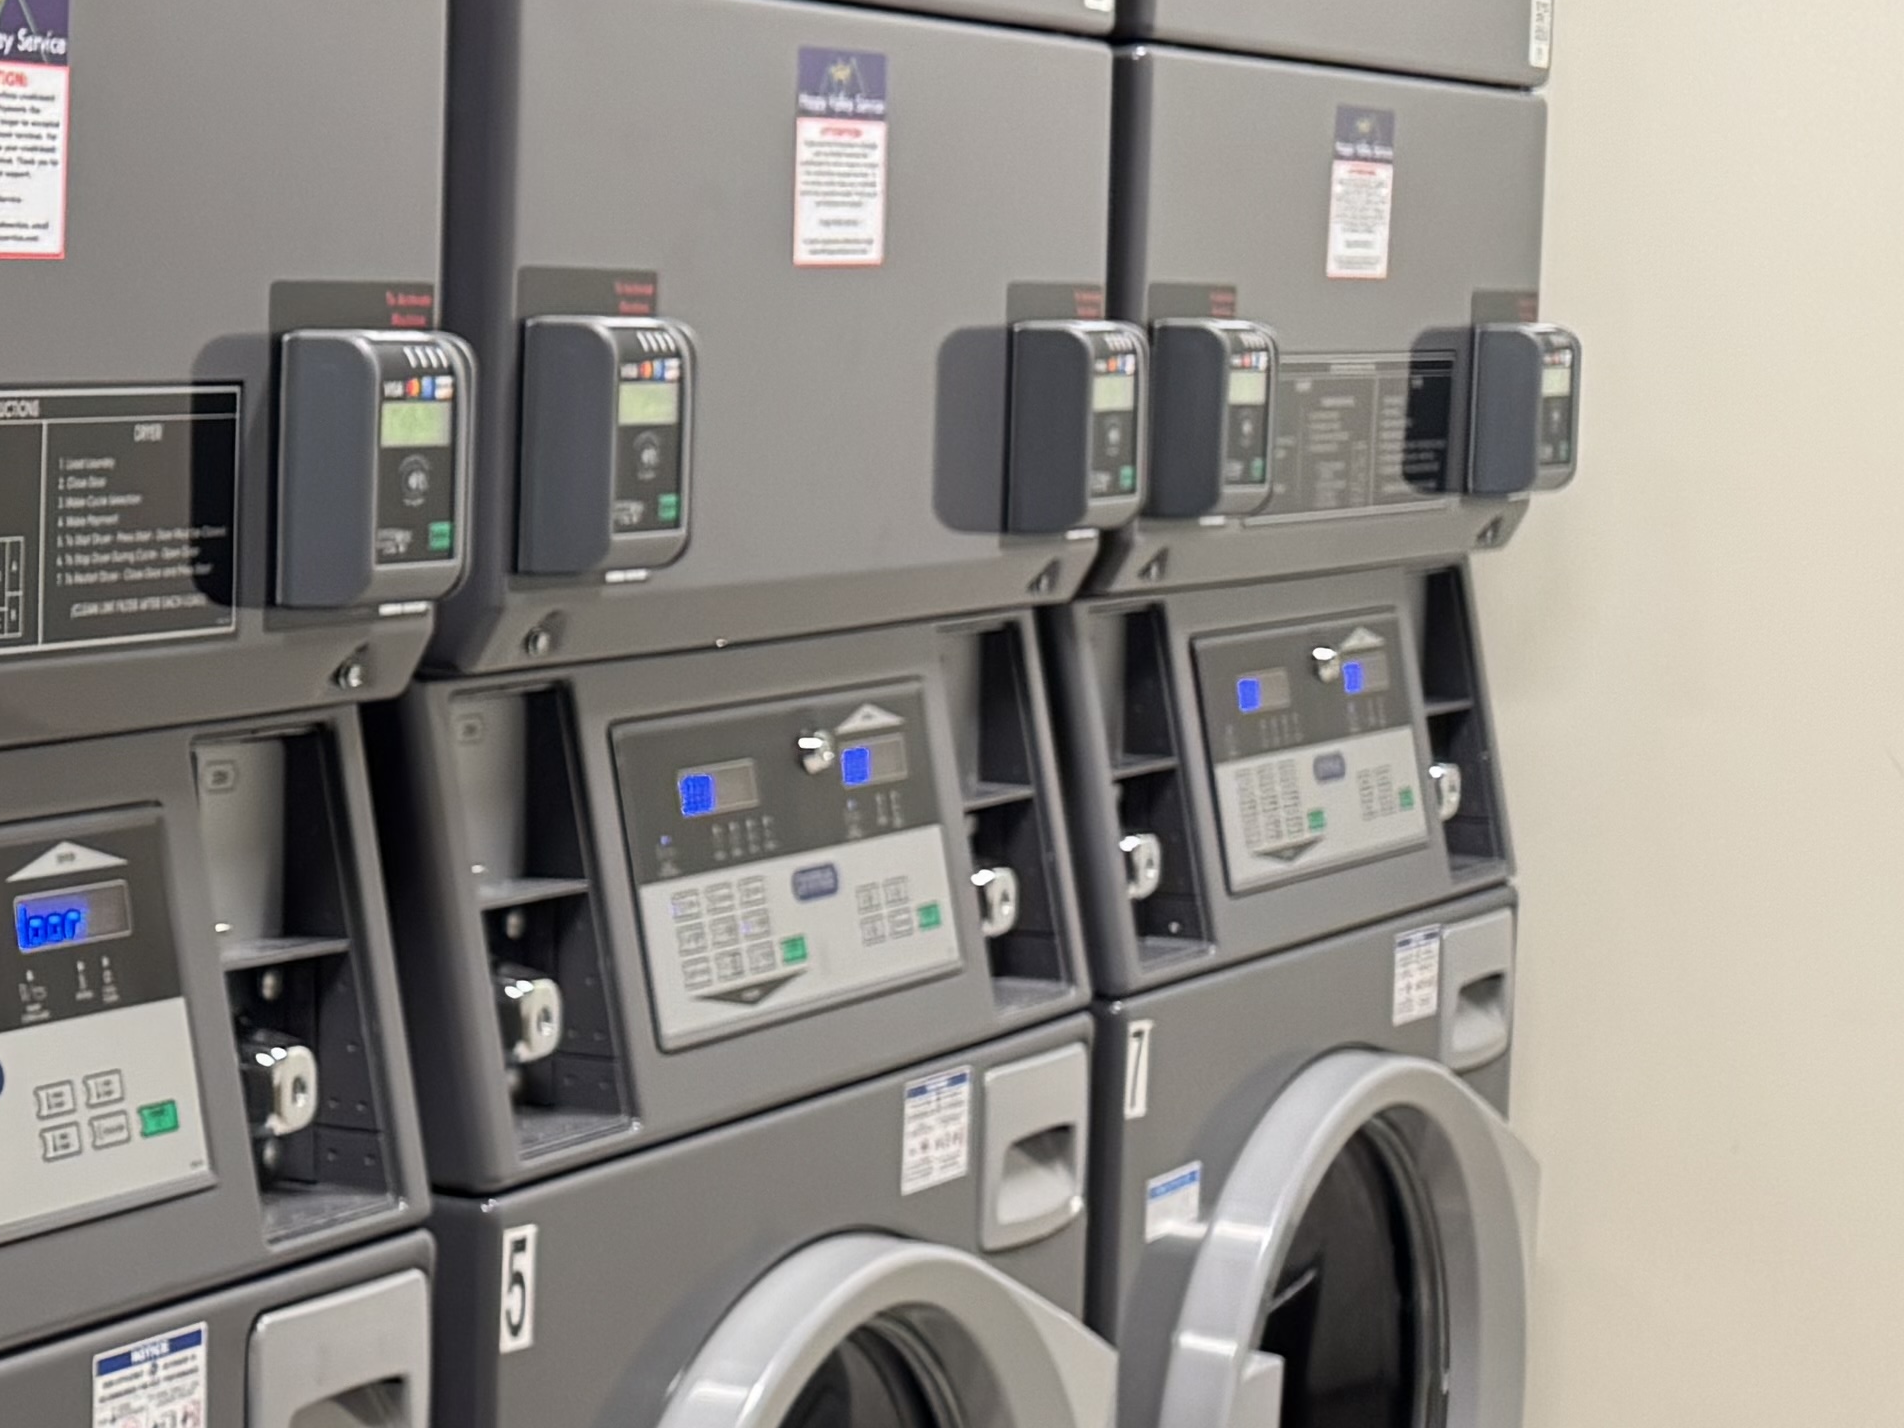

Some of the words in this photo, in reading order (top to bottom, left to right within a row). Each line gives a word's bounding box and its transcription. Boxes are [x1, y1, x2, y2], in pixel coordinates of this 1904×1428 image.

[17, 27, 67, 56] Service
[1130, 1029, 1145, 1110] 7
[505, 1237, 527, 1338] 5
